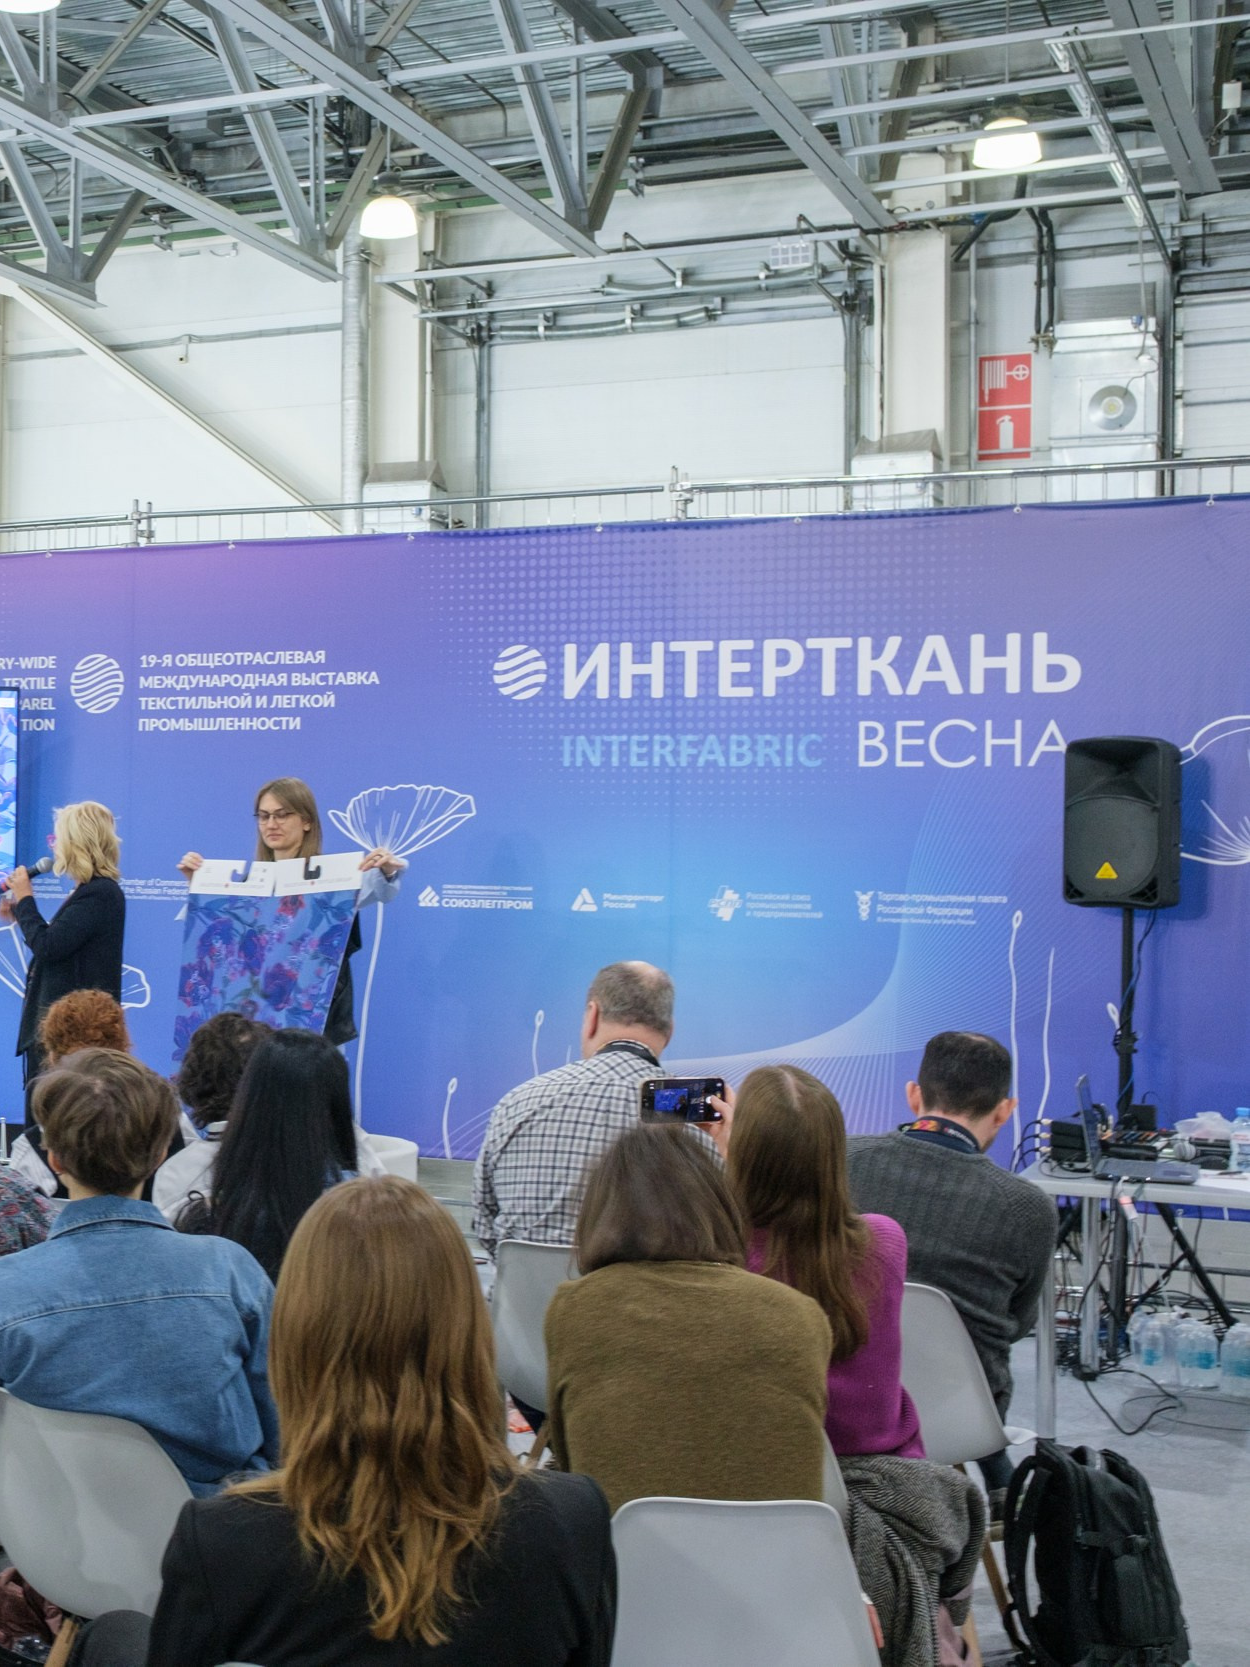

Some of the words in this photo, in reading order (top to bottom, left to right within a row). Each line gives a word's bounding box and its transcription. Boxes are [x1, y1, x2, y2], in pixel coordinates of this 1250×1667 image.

[140, 654, 172, 668] 19-Я
[175, 650, 326, 669] ОБЩЕОТРАСЛЕВАЯ
[563, 632, 1082, 699] ИНТЕРТКАНЬ
[3, 676, 56, 690] TEXTILE
[139, 673, 288, 690] МЕЖДУНАРОДНАЯ
[291, 671, 380, 686] ВЫСТАВКА
[19, 697, 56, 711] AREL
[138, 692, 252, 710] ТЕКСТИЛЬНОЙ
[255, 695, 268, 708] И
[270, 691, 335, 708] ЛЕГКОЙ
[20, 718, 55, 731] TION
[138, 716, 301, 731] ПРОМЫШЛЕННОСТИ
[562, 733, 823, 767] INTERFABRIC
[858, 719, 1067, 767] ВЕСНА
[155, 878, 188, 887] Commerc
[163, 887, 189, 895] Federat
[441, 898, 533, 910] СОЮЗЛЕГПРОМ
